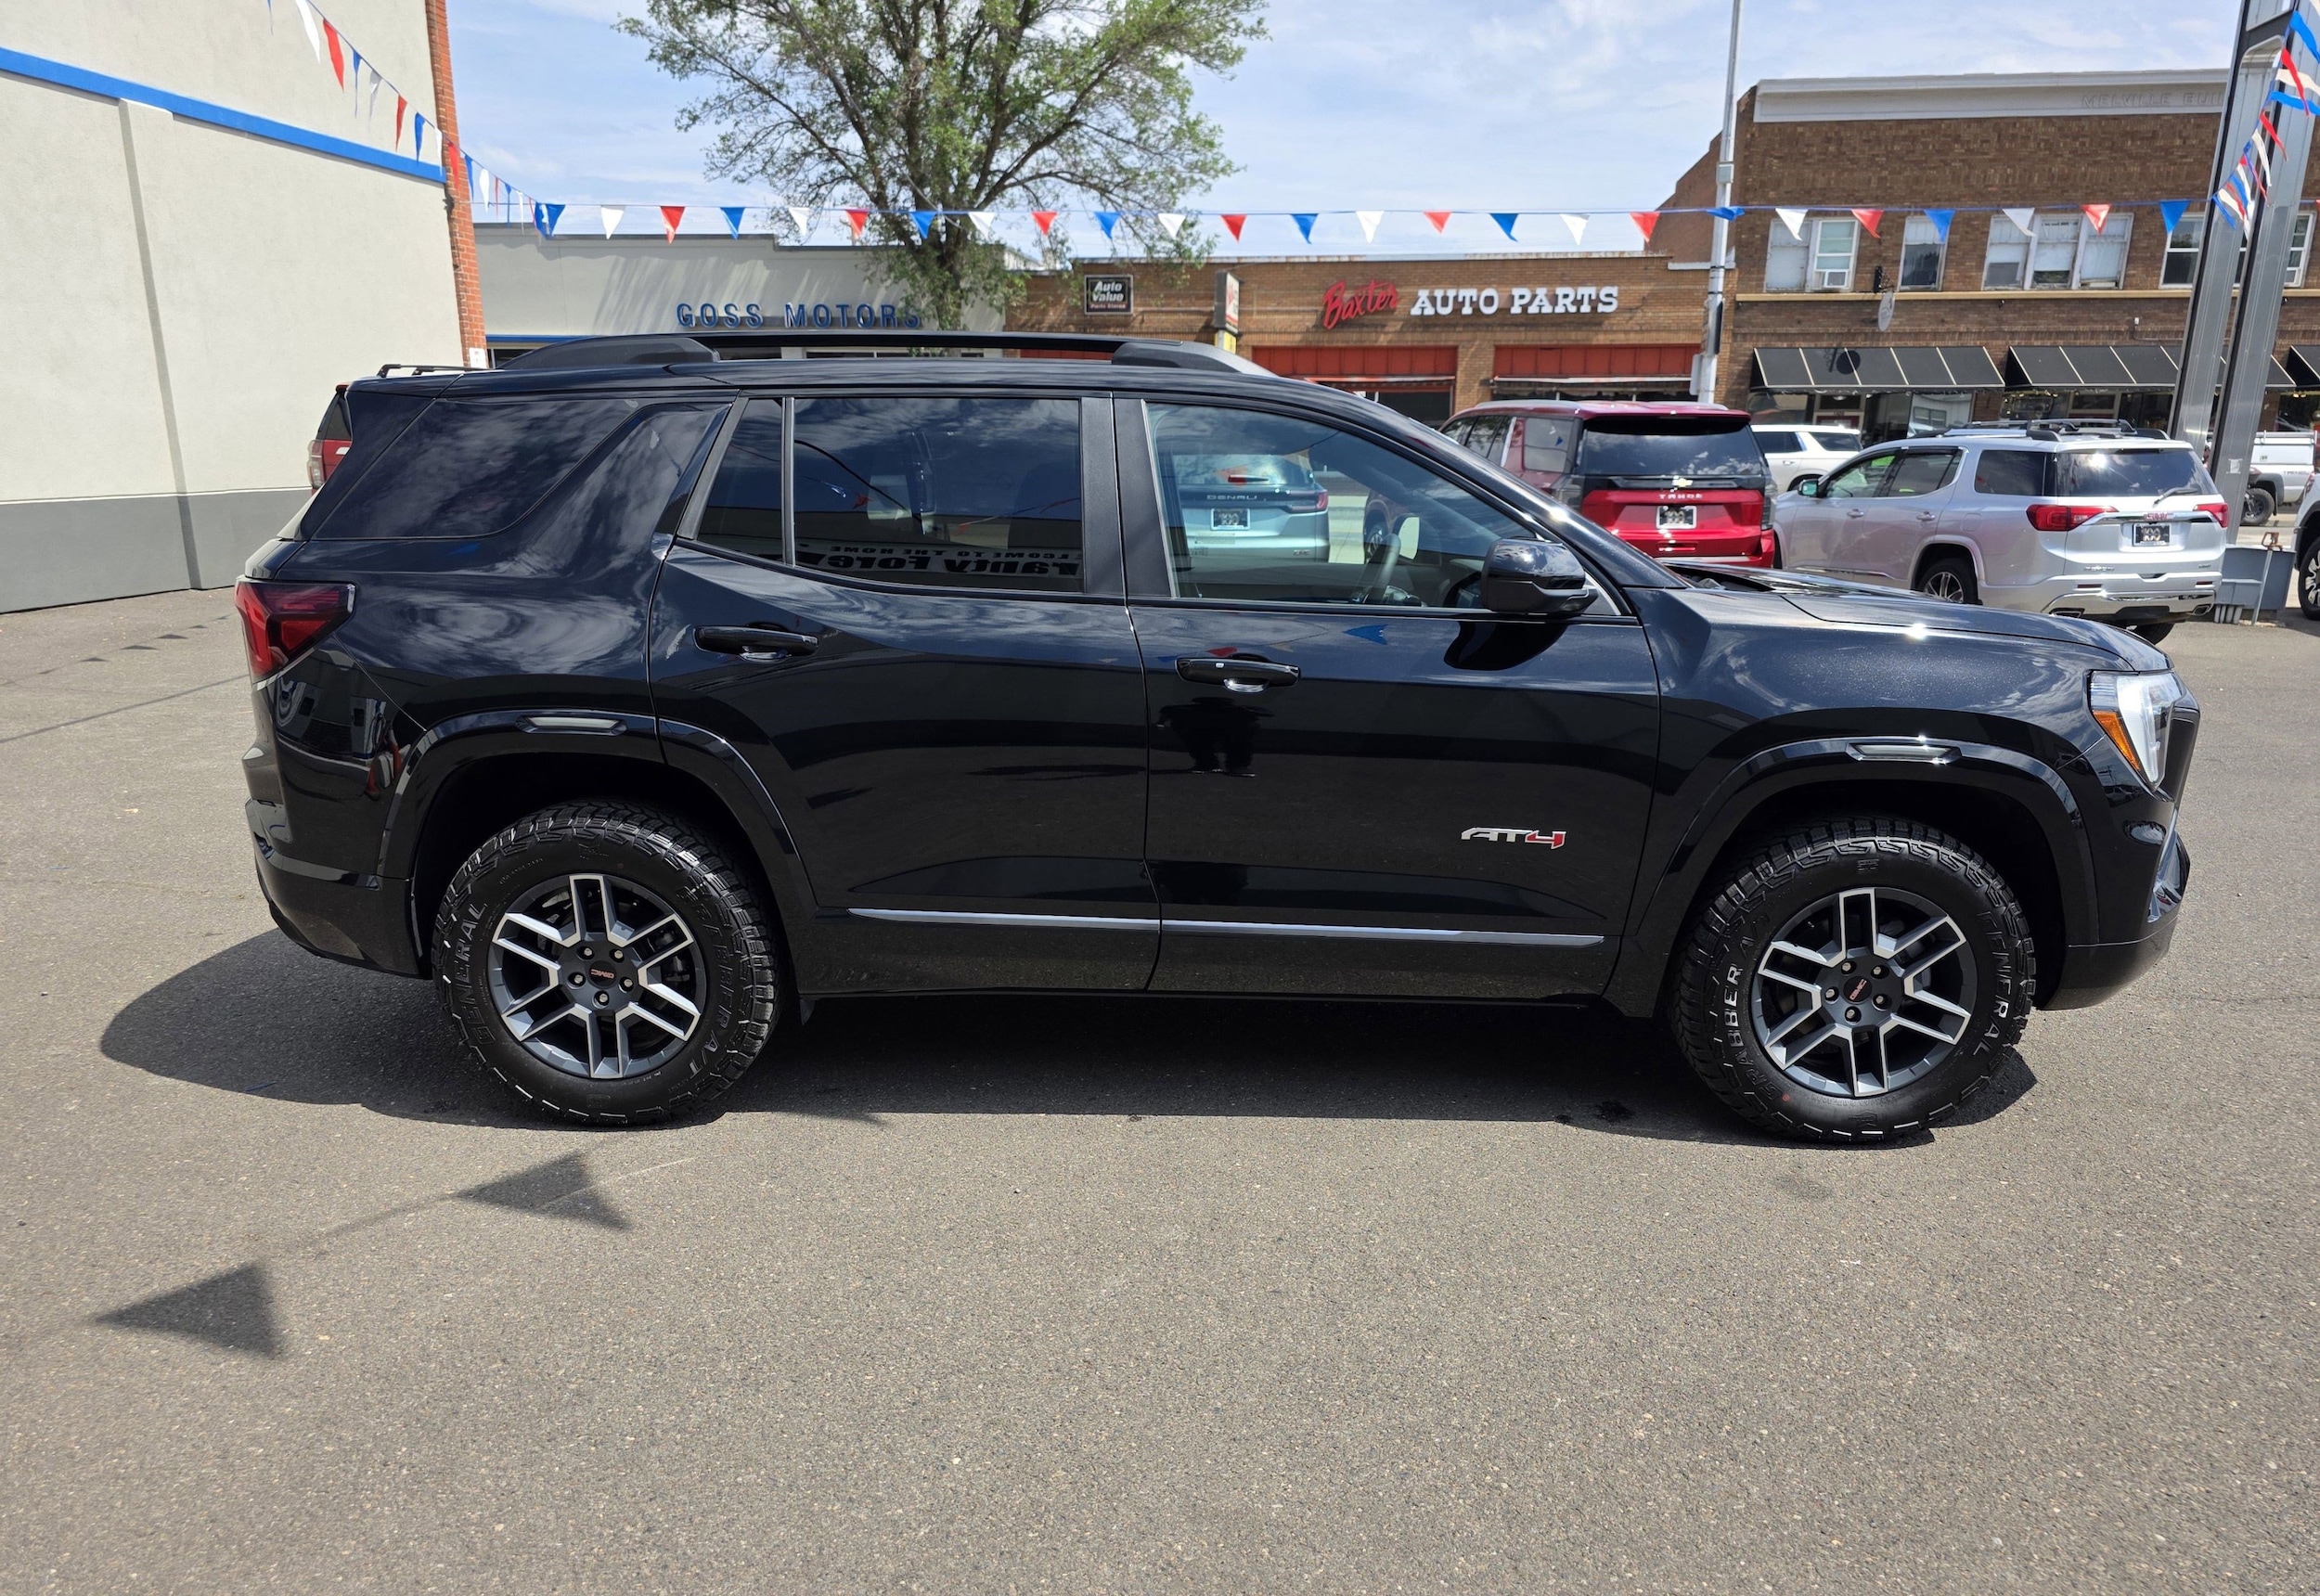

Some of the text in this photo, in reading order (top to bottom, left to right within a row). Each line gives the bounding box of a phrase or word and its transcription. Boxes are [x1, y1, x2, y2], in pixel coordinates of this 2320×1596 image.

[2082, 91, 2172, 108] MELVILLE
[1092, 290, 1125, 302] Value
[1093, 280, 1123, 292] Auto
[677, 302, 922, 328] GOSS MOTORS
[1322, 278, 1619, 329] Baxter AUTO PARTS
[1461, 827, 1566, 849] AT4
[455, 904, 496, 1045] GENERAL
[590, 968, 615, 980] GMC
[1973, 911, 2012, 1056] GENERAL
[1849, 978, 1868, 1001] GMC
[1723, 965, 1784, 1100] GRABBER
